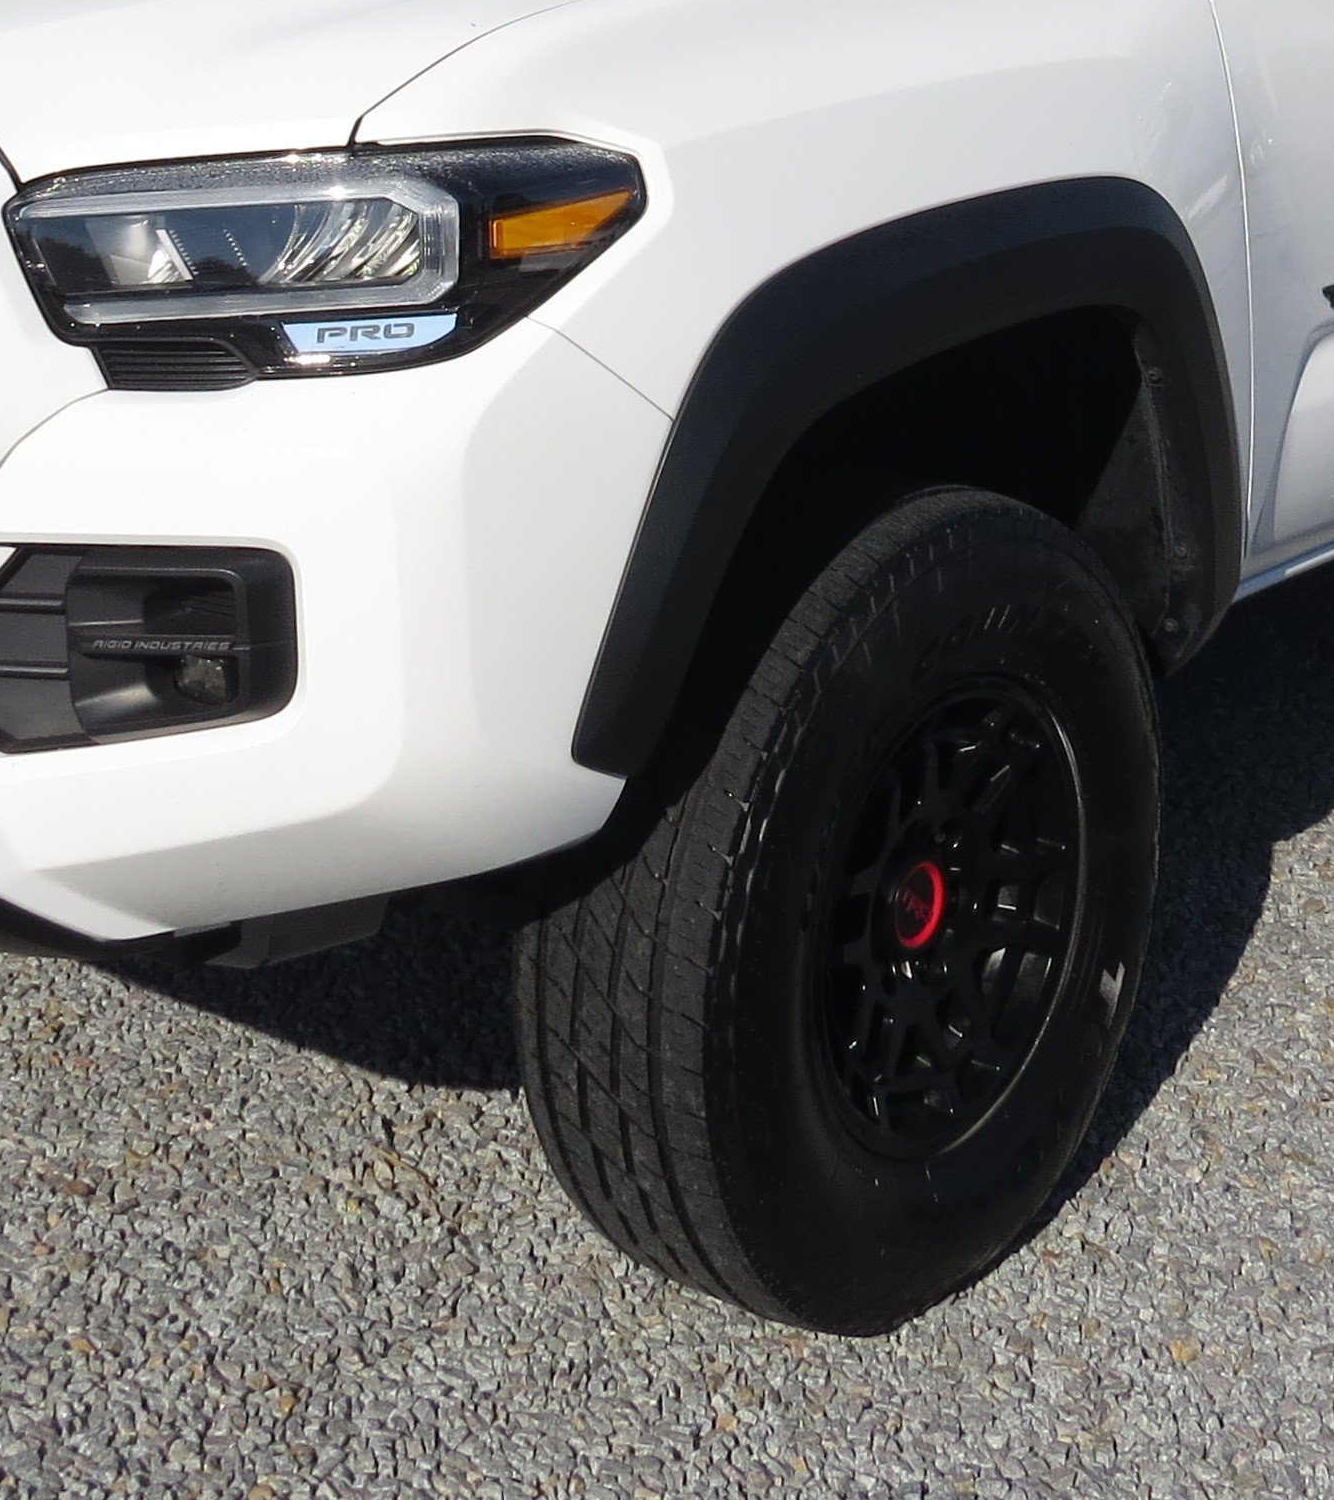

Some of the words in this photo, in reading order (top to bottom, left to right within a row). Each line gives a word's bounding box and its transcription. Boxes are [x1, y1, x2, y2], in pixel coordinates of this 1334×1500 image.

[317, 322, 415, 344] PRO
[92, 639, 133, 650] RIGID
[134, 640, 231, 651] INDUSTRIES
